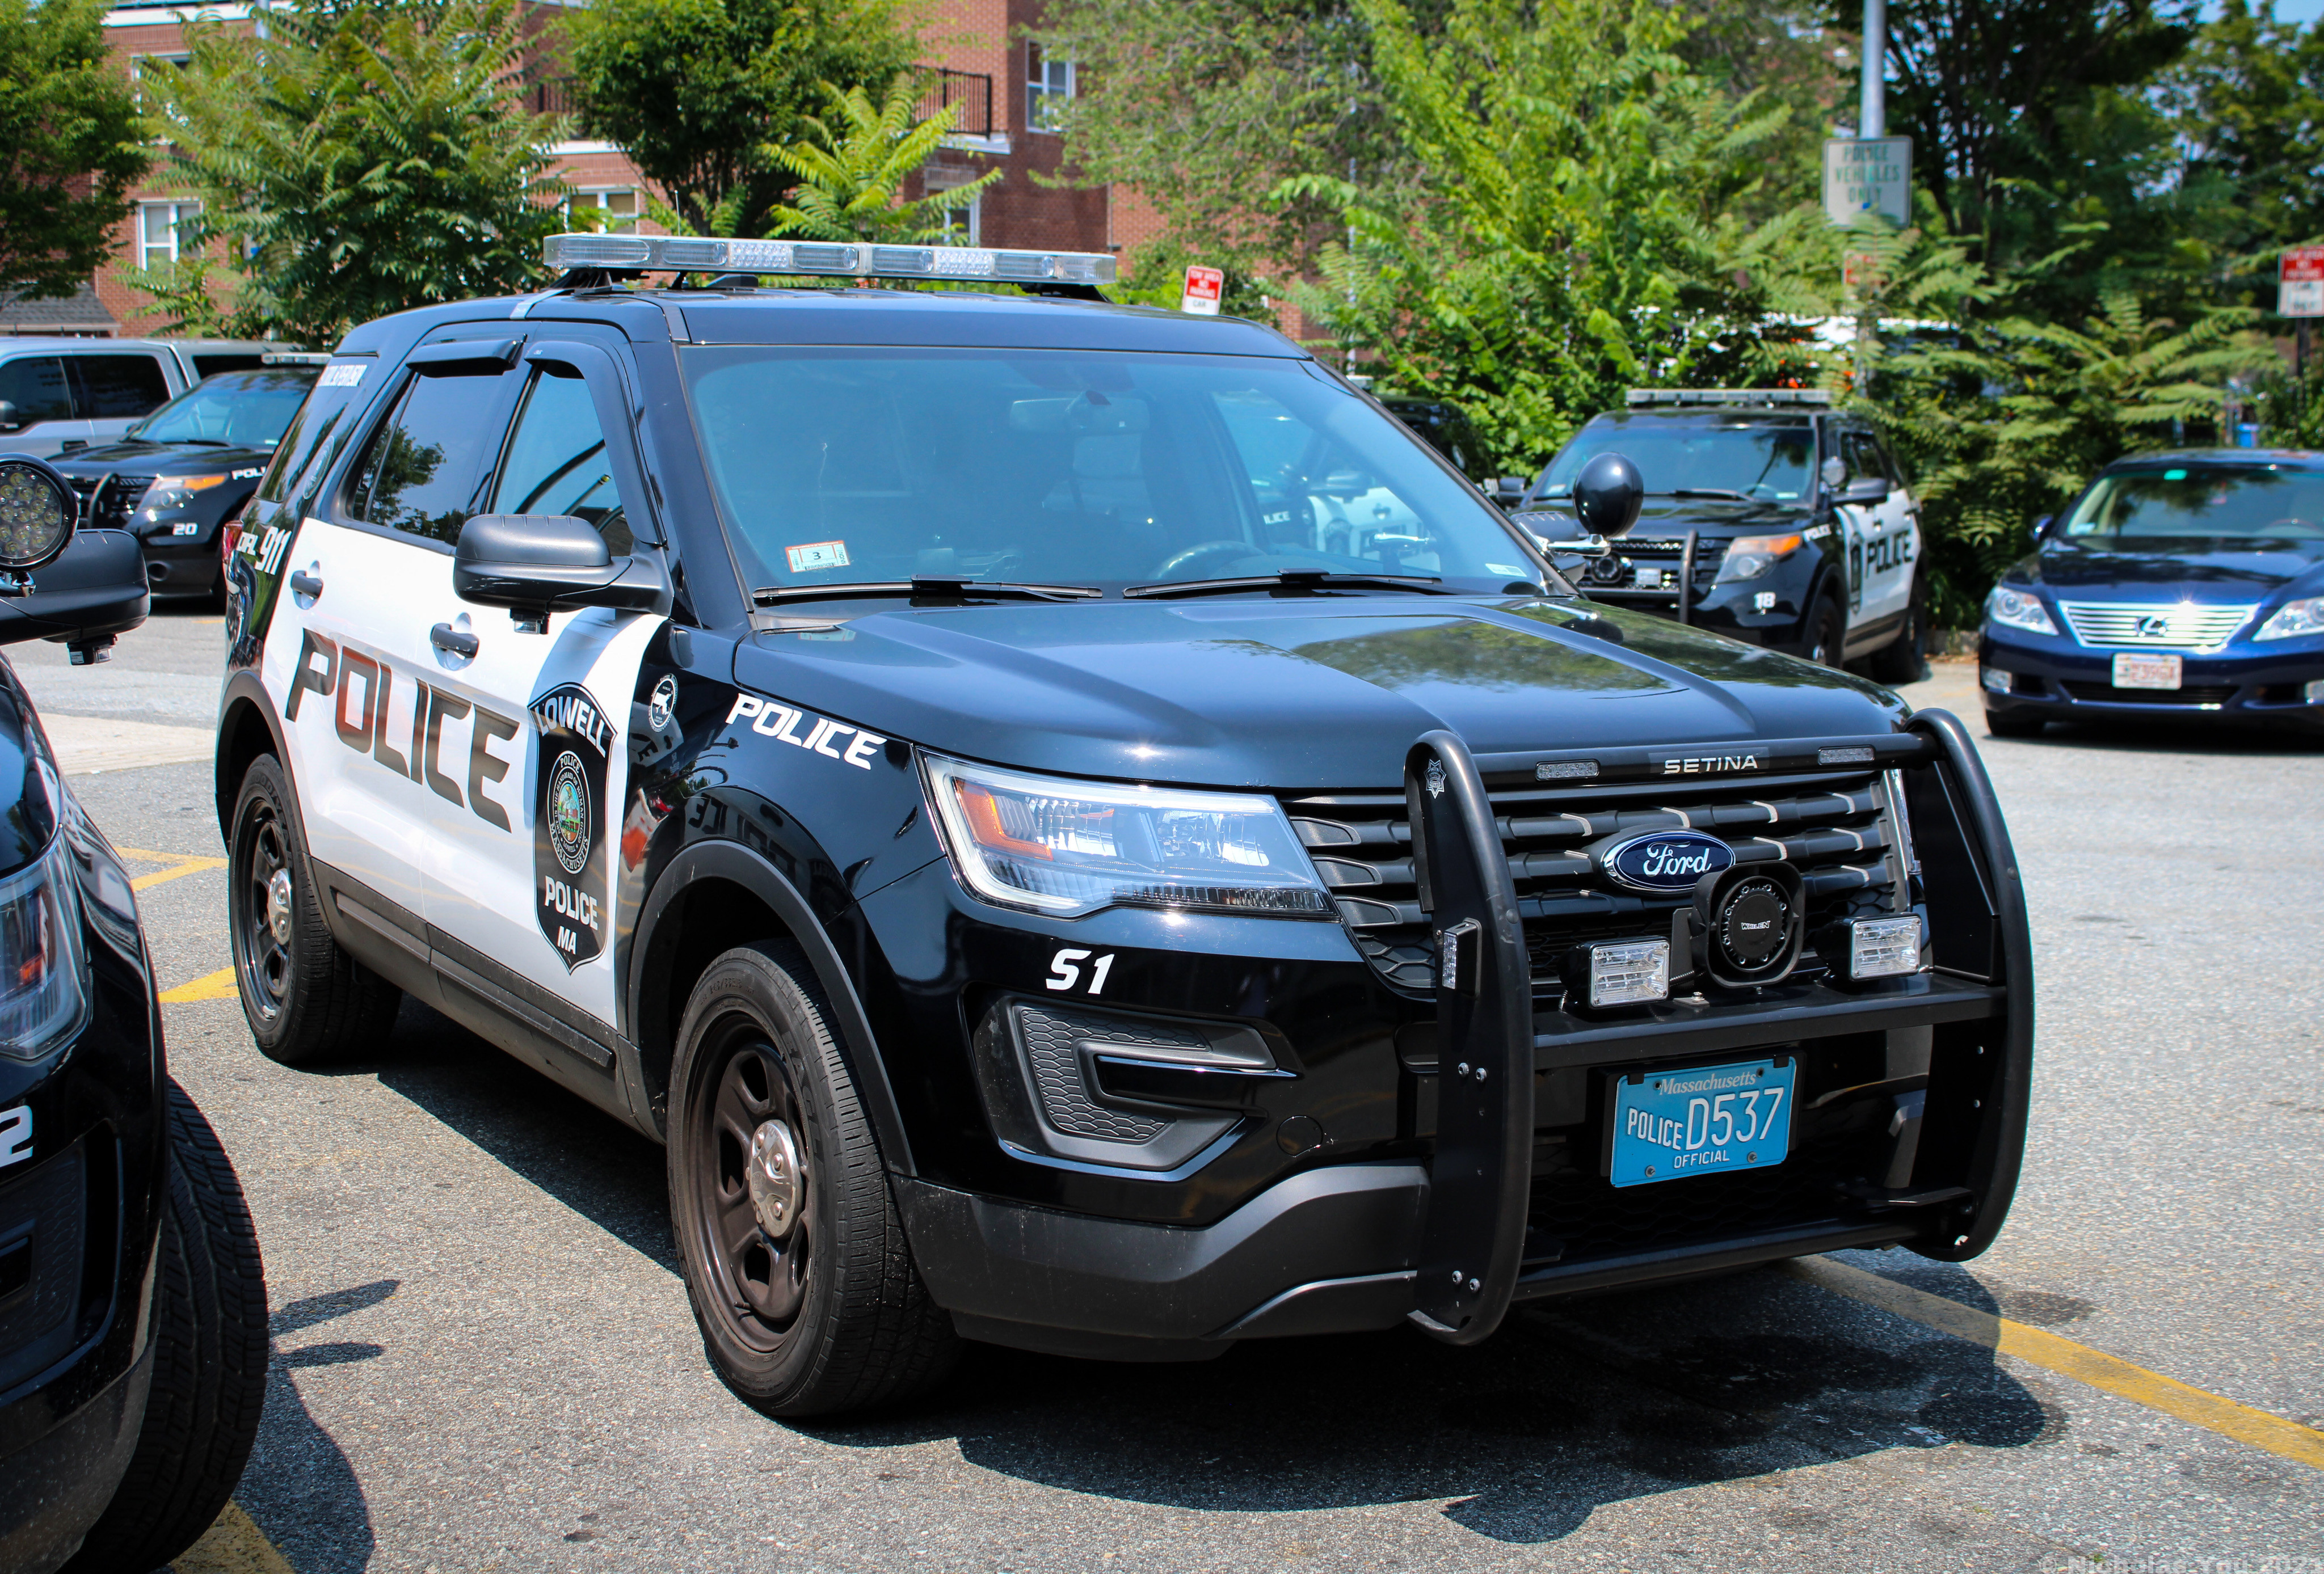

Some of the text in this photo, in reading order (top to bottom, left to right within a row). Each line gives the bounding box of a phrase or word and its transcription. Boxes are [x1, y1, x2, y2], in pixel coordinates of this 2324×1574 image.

[1843, 144, 1889, 161] POLICE
[1835, 165, 1900, 183] VEHICLES
[1848, 187, 1883, 202] ONLY
[172, 522, 199, 536] 20
[254, 526, 292, 576] 911
[812, 551, 822, 560] 3
[1865, 529, 1913, 579] POLICE
[1754, 591, 1776, 610] 18
[285, 627, 520, 834] POLICE
[534, 696, 606, 758] LOWELL
[725, 693, 887, 770] POLICE
[560, 755, 580, 774] POLICE
[1664, 755, 1758, 774] SETINA
[550, 822, 588, 870] MASSACHUSETTS
[1643, 841, 1712, 877] Ford
[545, 875, 598, 931] POLICE
[1741, 920, 1771, 930] WHELEN
[557, 926, 577, 955] MA
[1046, 948, 1115, 994] S1
[1658, 1071, 1757, 1095] Massachusetts
[1627, 1087, 1784, 1151] POLICE D537
[0, 1105, 33, 1168] 2
[1674, 1150, 1731, 1169] OFFICIAL
